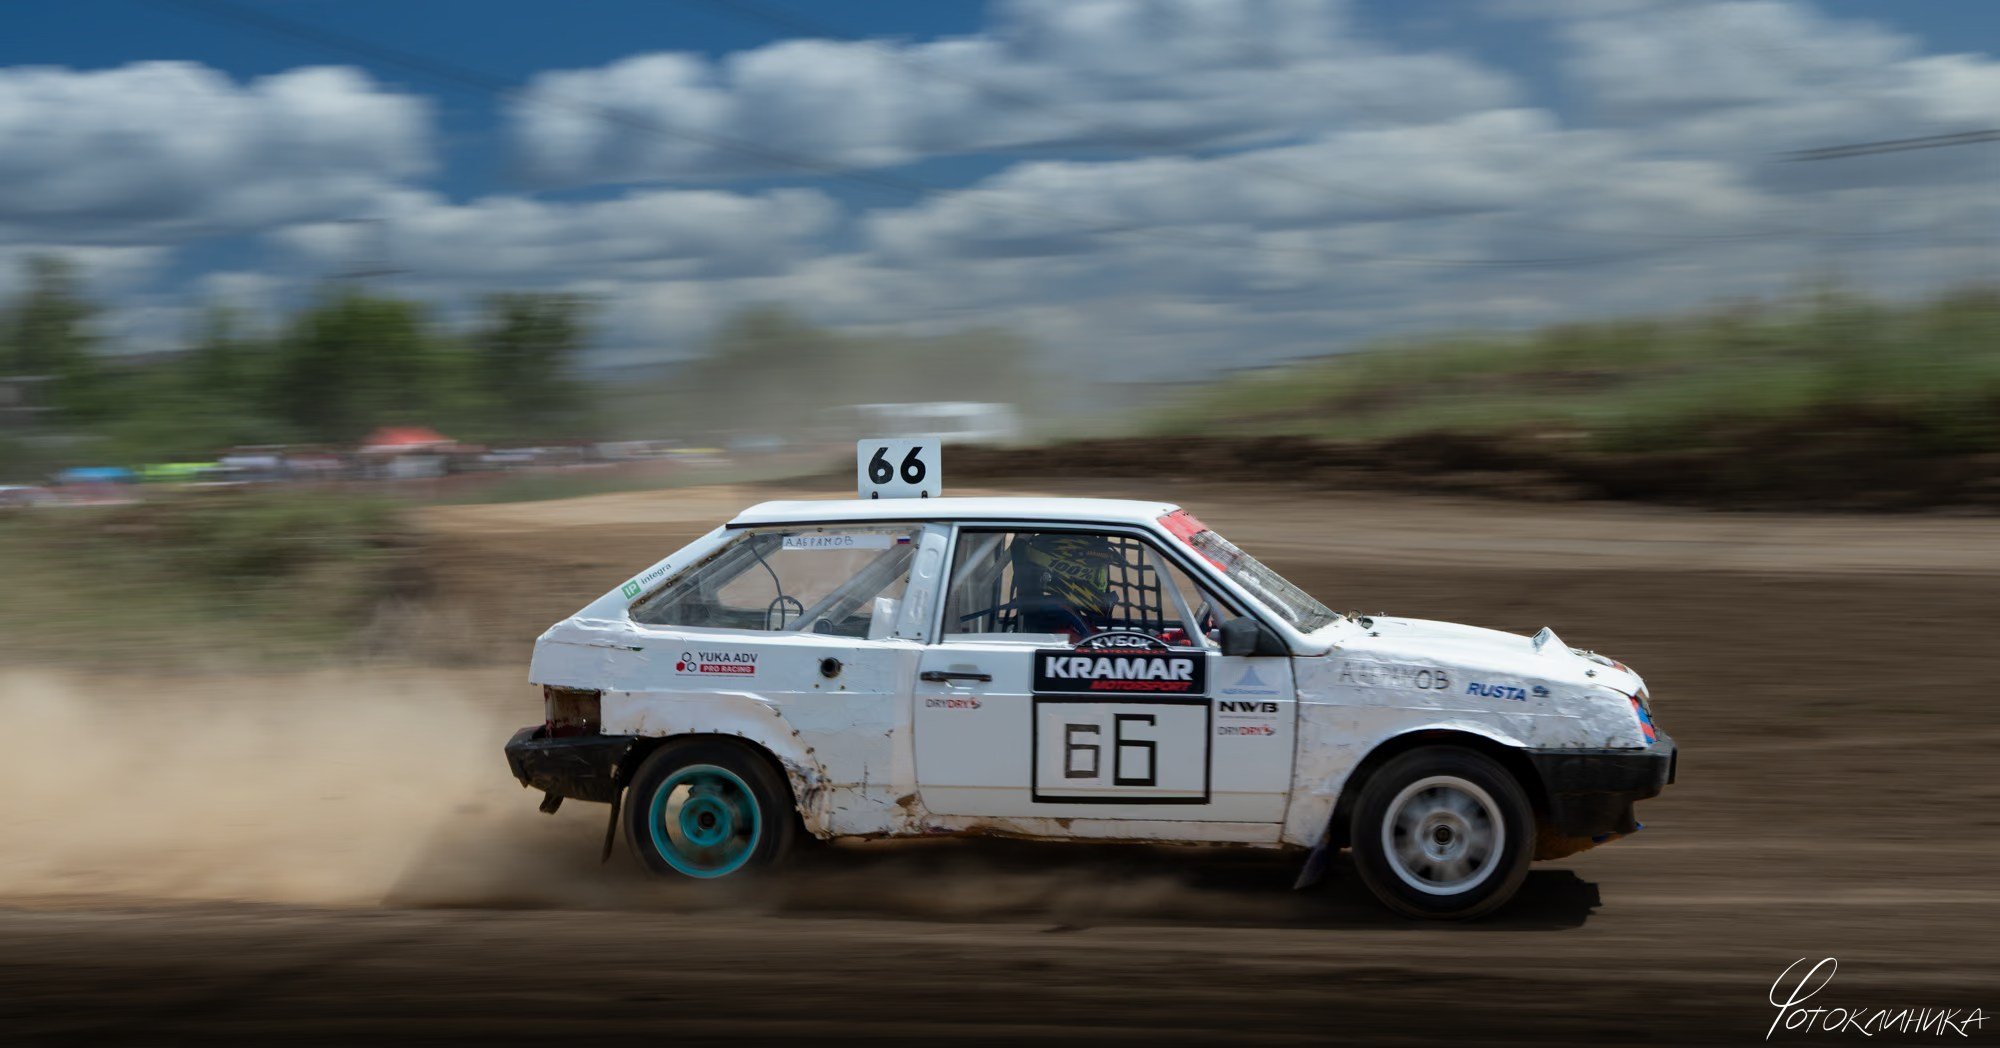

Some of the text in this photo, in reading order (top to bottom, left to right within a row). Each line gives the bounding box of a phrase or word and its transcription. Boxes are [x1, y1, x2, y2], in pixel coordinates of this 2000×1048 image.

[868, 446, 926, 485] 66
[641, 563, 672, 585] integra
[1048, 560, 1094, 580] 100%
[699, 652, 758, 663] YUKA ADV
[703, 665, 720, 673] PRO
[1045, 656, 1194, 680] KRAMAR
[1090, 680, 1193, 691] MOTORSPORT
[1466, 682, 1527, 702] RUSTA
[1219, 701, 1279, 713] NWB
[1065, 713, 1157, 787] 66
